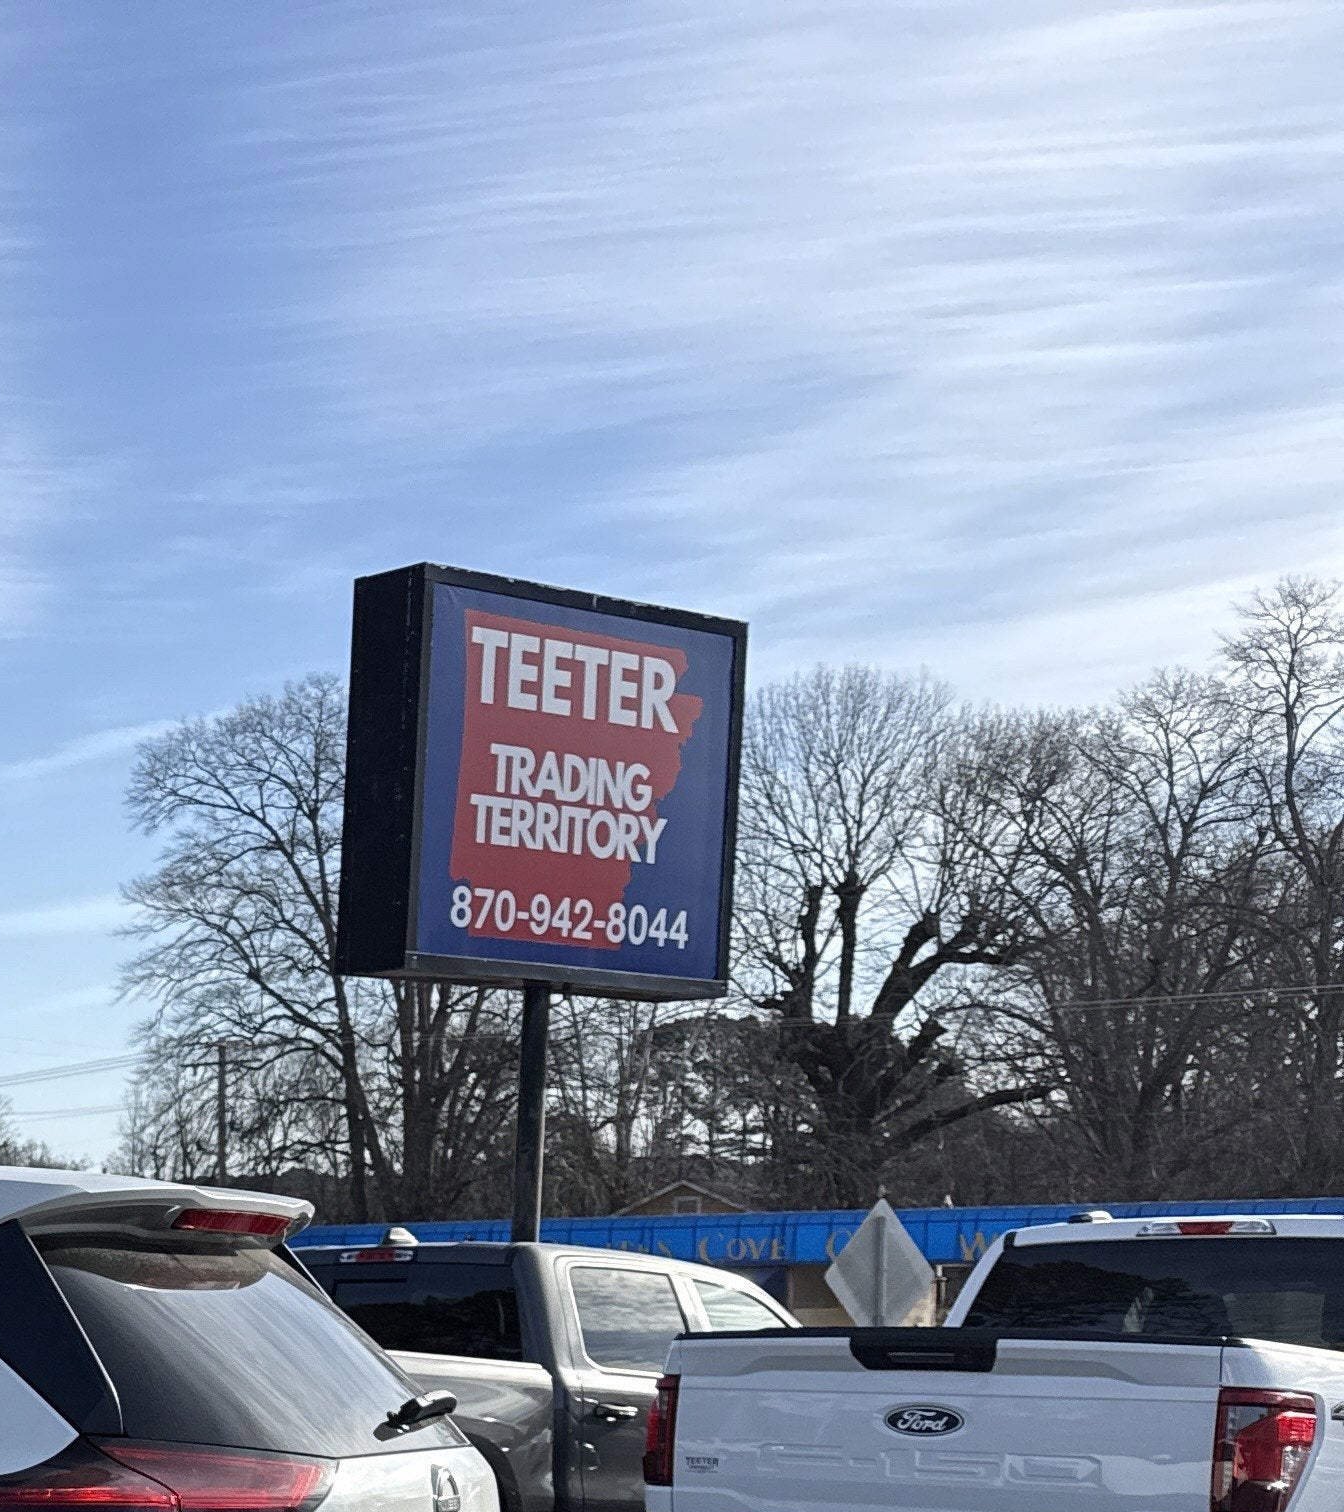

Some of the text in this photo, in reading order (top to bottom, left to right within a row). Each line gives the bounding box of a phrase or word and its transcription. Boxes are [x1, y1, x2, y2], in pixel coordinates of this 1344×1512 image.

[472, 626, 679, 734] TEETER
[490, 742, 652, 812] TRADING
[470, 793, 668, 865] TERRITORY
[450, 885, 690, 950] 870-942-8044
[896, 1409, 949, 1431] Ford
